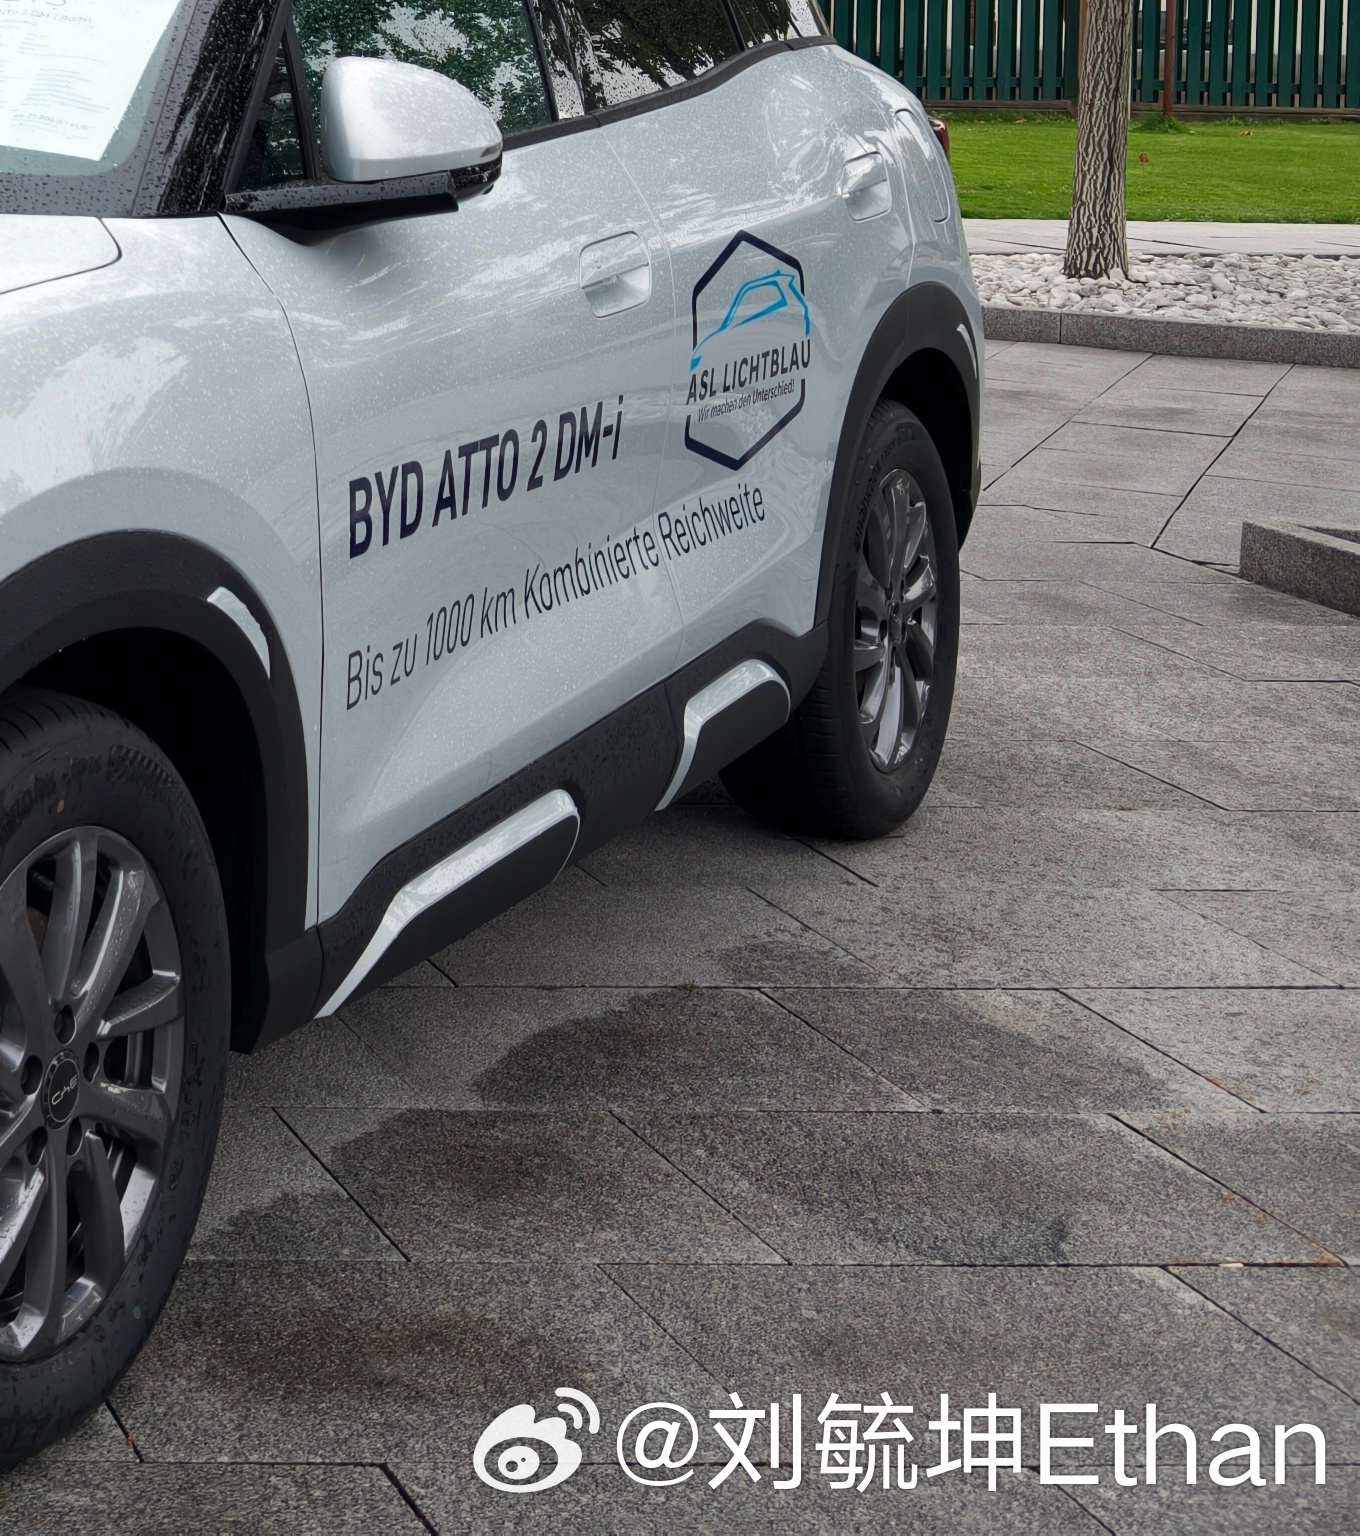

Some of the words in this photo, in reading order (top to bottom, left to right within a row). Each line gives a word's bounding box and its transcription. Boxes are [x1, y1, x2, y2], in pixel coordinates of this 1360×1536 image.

[686, 368, 716, 405] ASL
[723, 339, 810, 393] LICHTBLAU
[710, 397, 737, 419] machen
[738, 394, 751, 409] den
[752, 378, 795, 404] Unterschied!
[349, 459, 424, 559] BYD
[432, 428, 520, 527] ATTO
[527, 419, 548, 492] 2
[554, 395, 625, 482] DM-i
[347, 646, 384, 710] Bis
[390, 633, 418, 686] zu
[425, 593, 475, 666] 1000
[480, 587, 517, 638] km
[524, 526, 660, 618] Kombinierte
[657, 483, 766, 561] Reichweite
